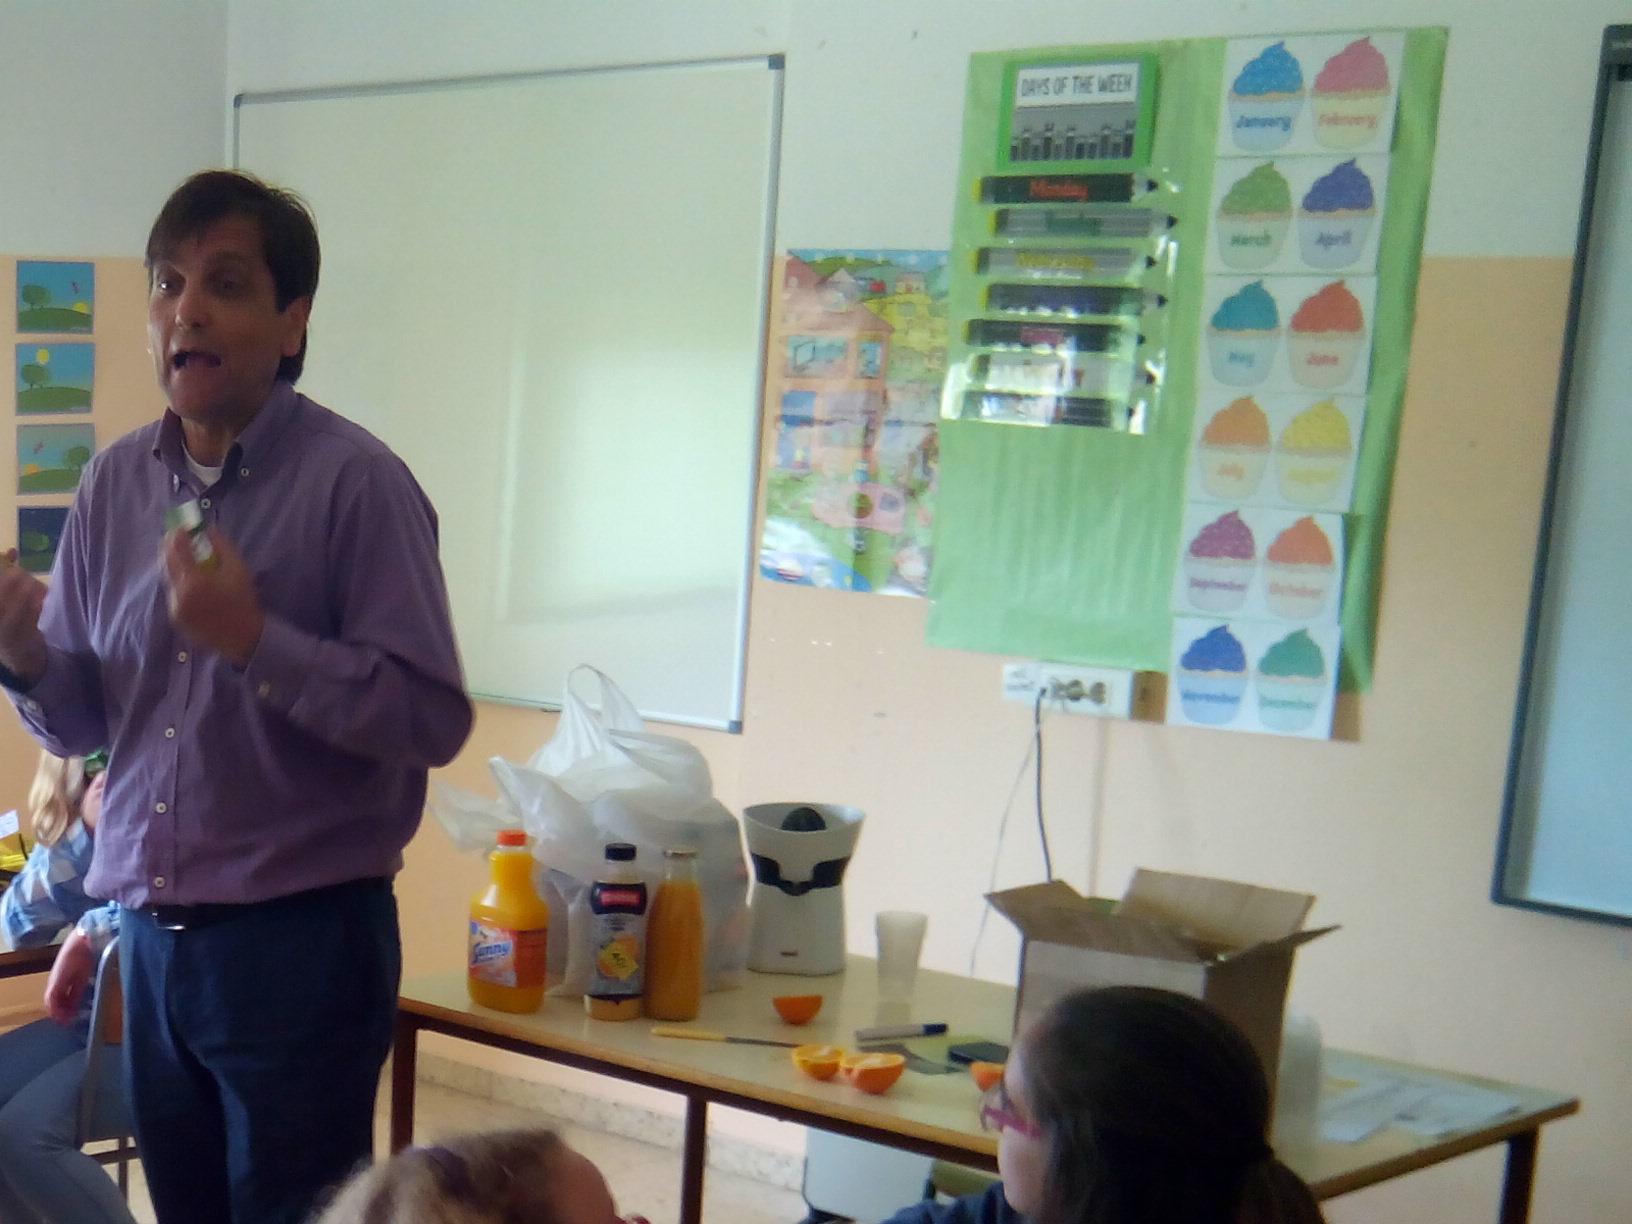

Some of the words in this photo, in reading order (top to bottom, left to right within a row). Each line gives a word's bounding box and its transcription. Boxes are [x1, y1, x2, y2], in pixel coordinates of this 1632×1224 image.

[1021, 76, 1050, 97] DAYS
[1053, 76, 1069, 96] OF
[1072, 75, 1095, 94] THE
[1097, 73, 1132, 93] WEEK
[1236, 115, 1292, 132] January
